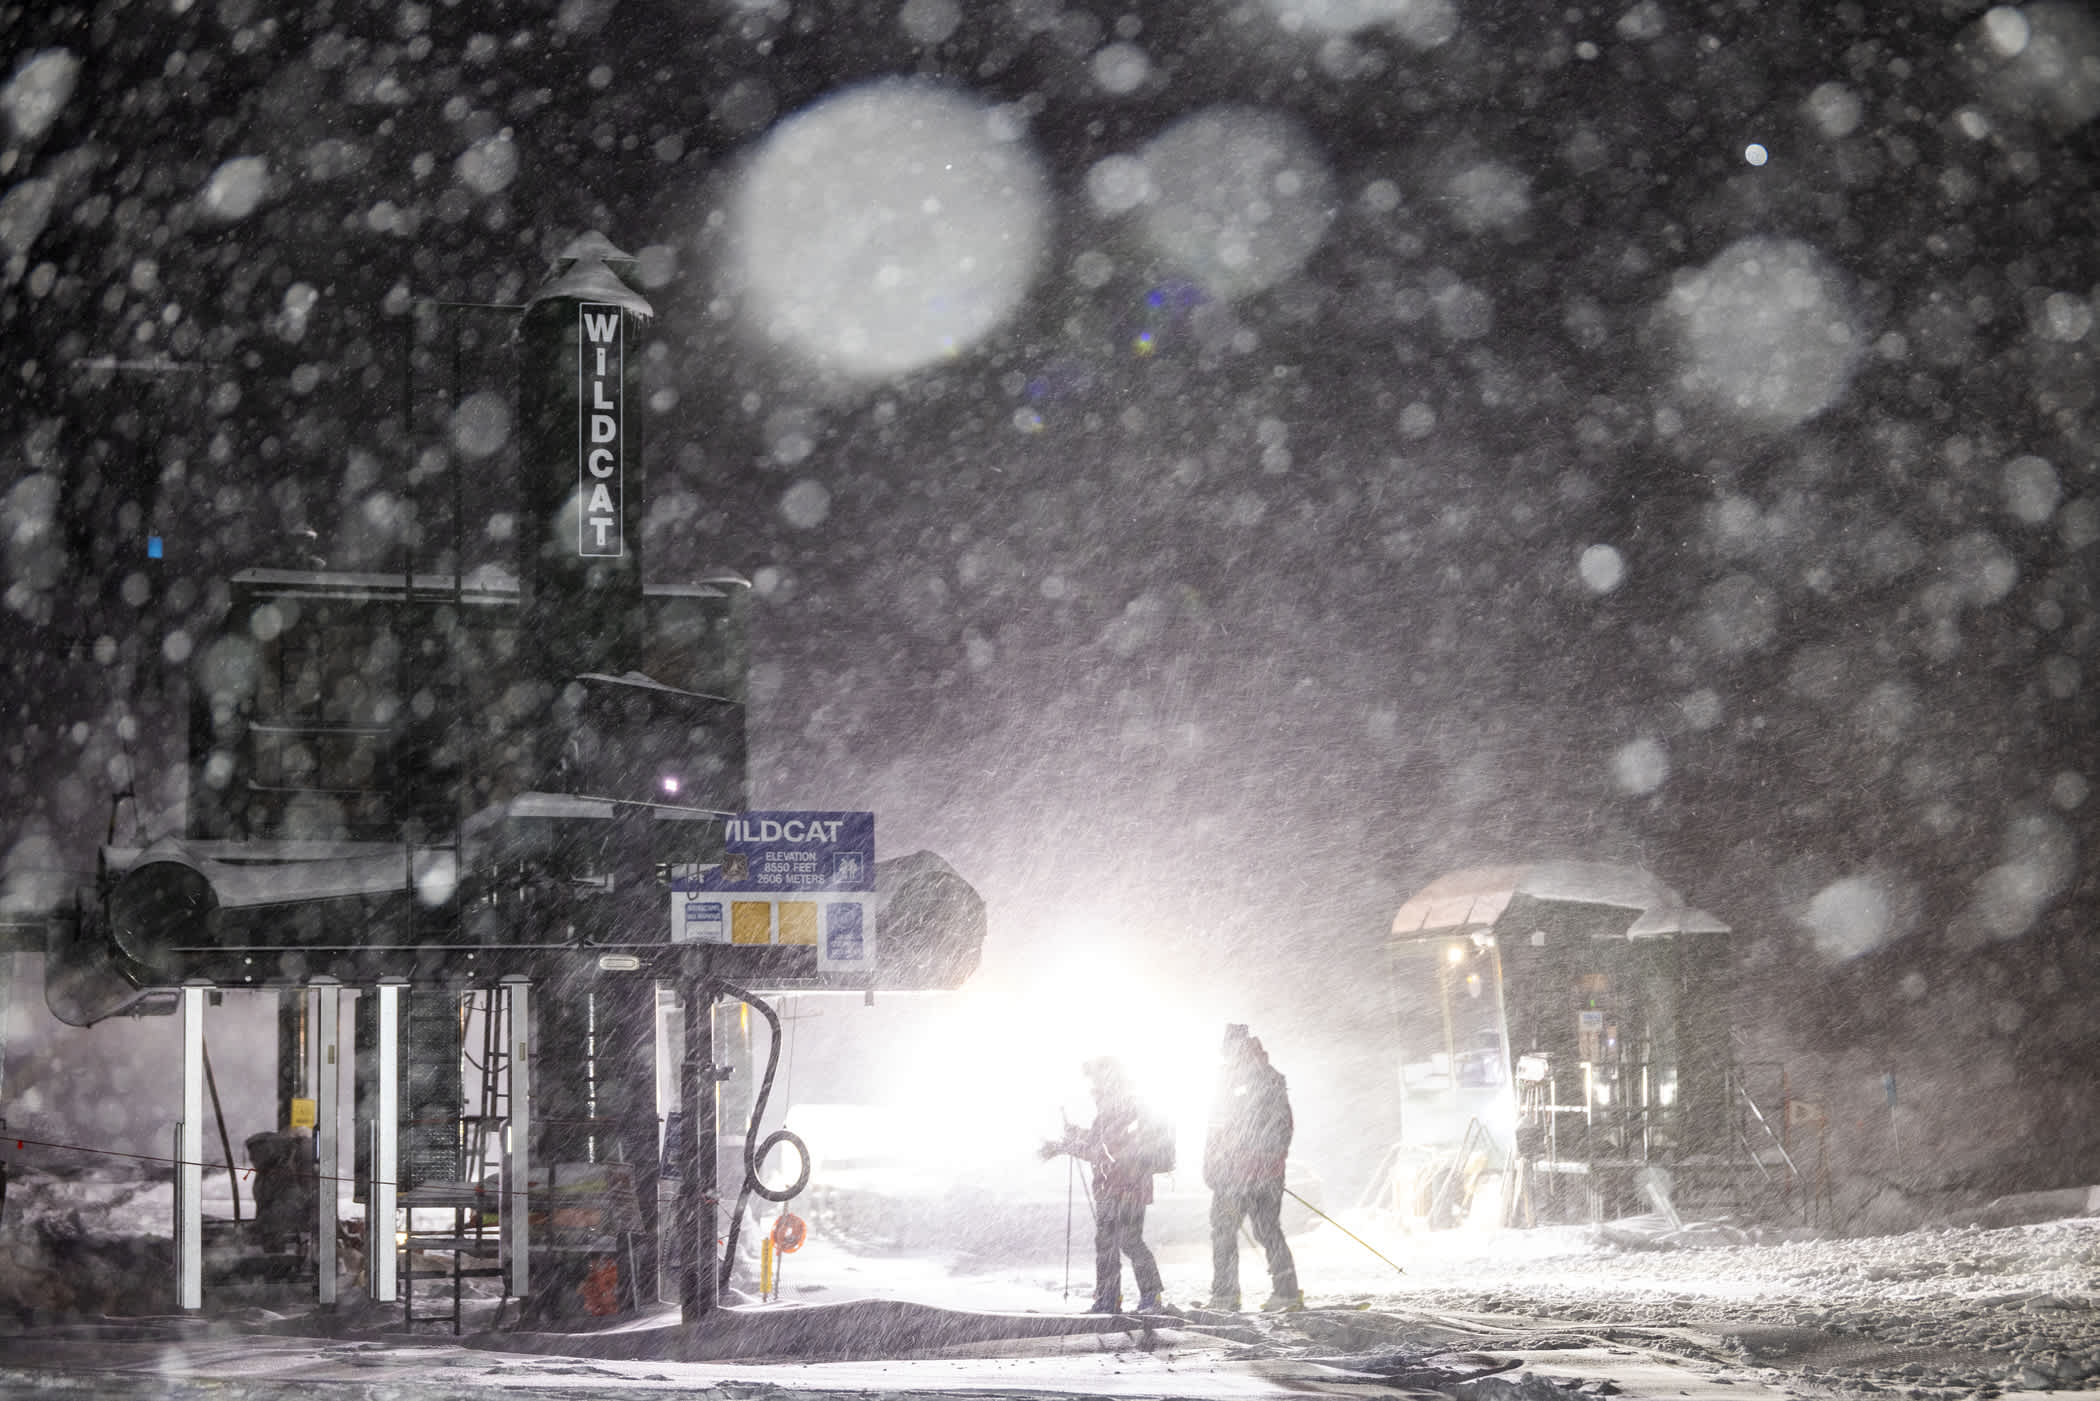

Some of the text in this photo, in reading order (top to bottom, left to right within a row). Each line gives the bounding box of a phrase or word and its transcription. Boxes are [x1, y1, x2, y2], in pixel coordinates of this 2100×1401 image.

[584, 313, 618, 546] WILDCAT
[766, 852, 816, 861] ELEVATION
[764, 863, 817, 872] 8550 FEET
[757, 874, 825, 884] 2606 METERS
